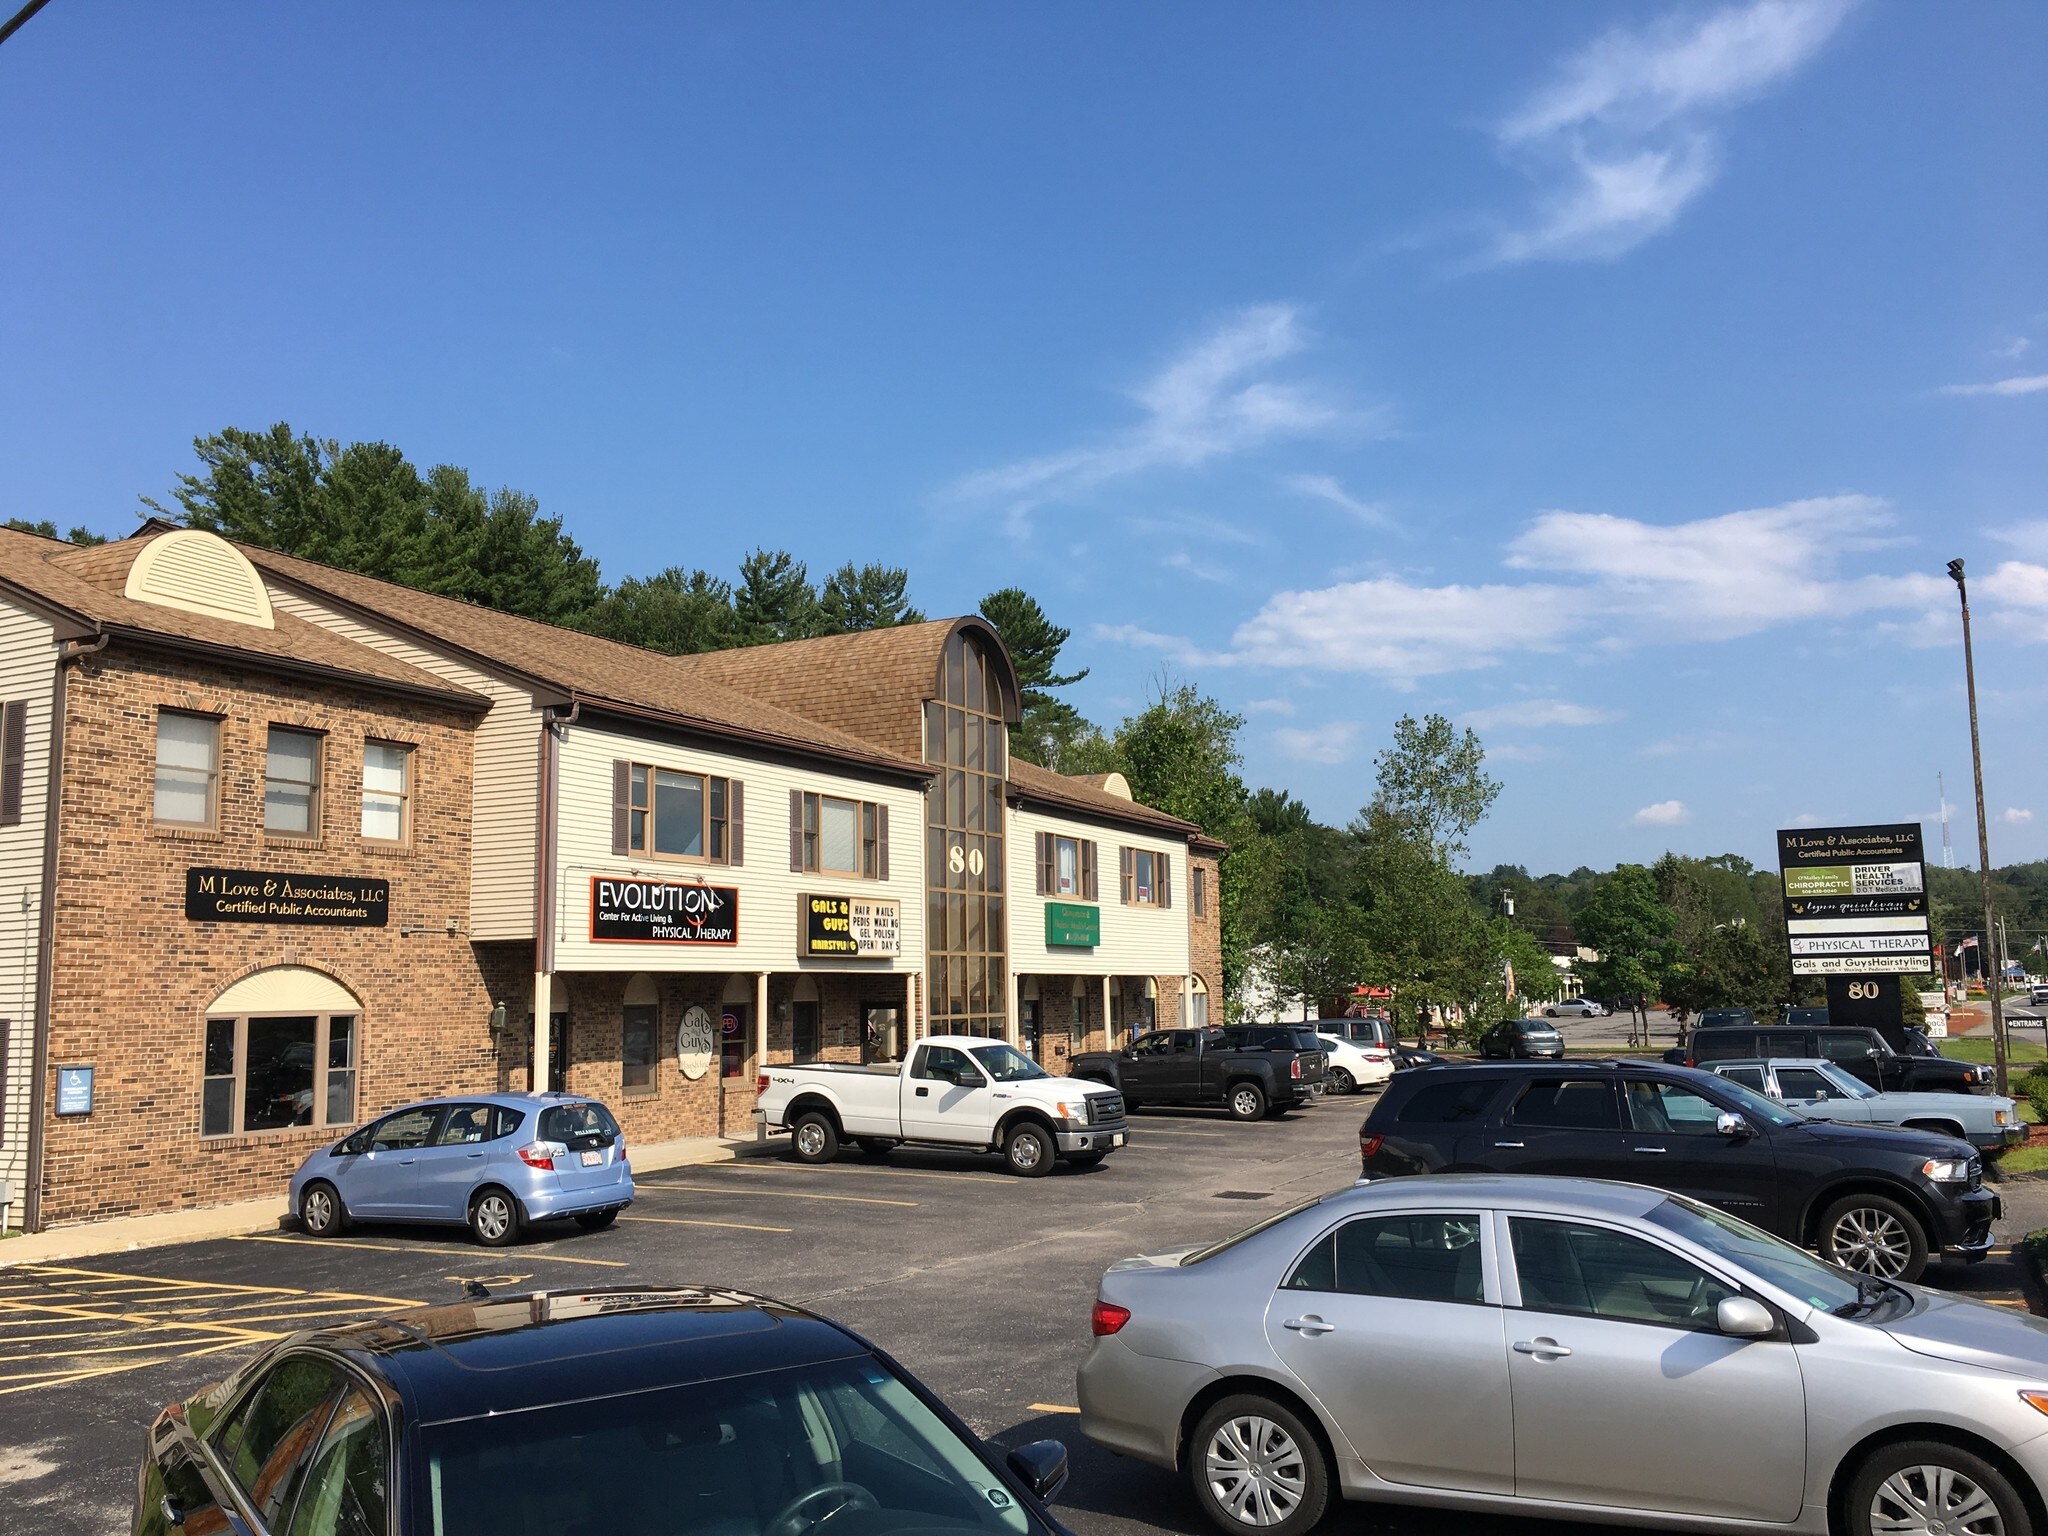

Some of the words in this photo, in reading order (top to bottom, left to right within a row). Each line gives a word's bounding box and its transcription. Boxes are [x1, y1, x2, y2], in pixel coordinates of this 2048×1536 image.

[1786, 838, 1797, 847] M
[1800, 837, 1824, 847] Love
[1827, 836, 1836, 845] &
[1839, 835, 1893, 845] Associates,
[1896, 834, 1914, 842] LLC
[1798, 850, 1830, 858] Certified
[1856, 847, 1903, 855] Accountants
[949, 846, 983, 875] 80
[1854, 866, 1891, 874] DRIVER
[1855, 872, 1894, 880] HEALTH
[1788, 880, 1850, 889] CHIROPRACTIC
[1856, 878, 1903, 887] SERVICES
[198, 876, 215, 894] M
[221, 877, 259, 896] Love
[263, 879, 278, 897] &
[280, 880, 357, 904] Associates,
[360, 889, 384, 902] LLC
[599, 882, 715, 912] EVOLUTION
[216, 900, 266, 913] Certified
[270, 903, 302, 915] Public
[304, 904, 368, 918] Accountants
[812, 900, 837, 914] GALS
[840, 902, 848, 914] &
[855, 906, 870, 915] HAIR
[876, 907, 894, 917] NAILS
[600, 912, 619, 921] Center
[621, 913, 630, 921] For
[632, 913, 649, 922] Active
[650, 914, 666, 924] Living
[668, 915, 672, 923] &
[853, 917, 870, 926] PEDIS
[823, 918, 848, 931] GUYS
[652, 926, 692, 938] PHYSICAL
[860, 929, 870, 938] GEL
[874, 930, 895, 939] POLISH
[859, 940, 873, 949] OPEN
[1809, 941, 1864, 951] PHYSICAL
[1870, 938, 1926, 948] THERAPY
[1793, 960, 1816, 968] Gals
[1822, 959, 1840, 968] and
[1848, 981, 1879, 999] 80
[684, 1012, 711, 1034] Gals
[681, 1032, 711, 1056] Guys
